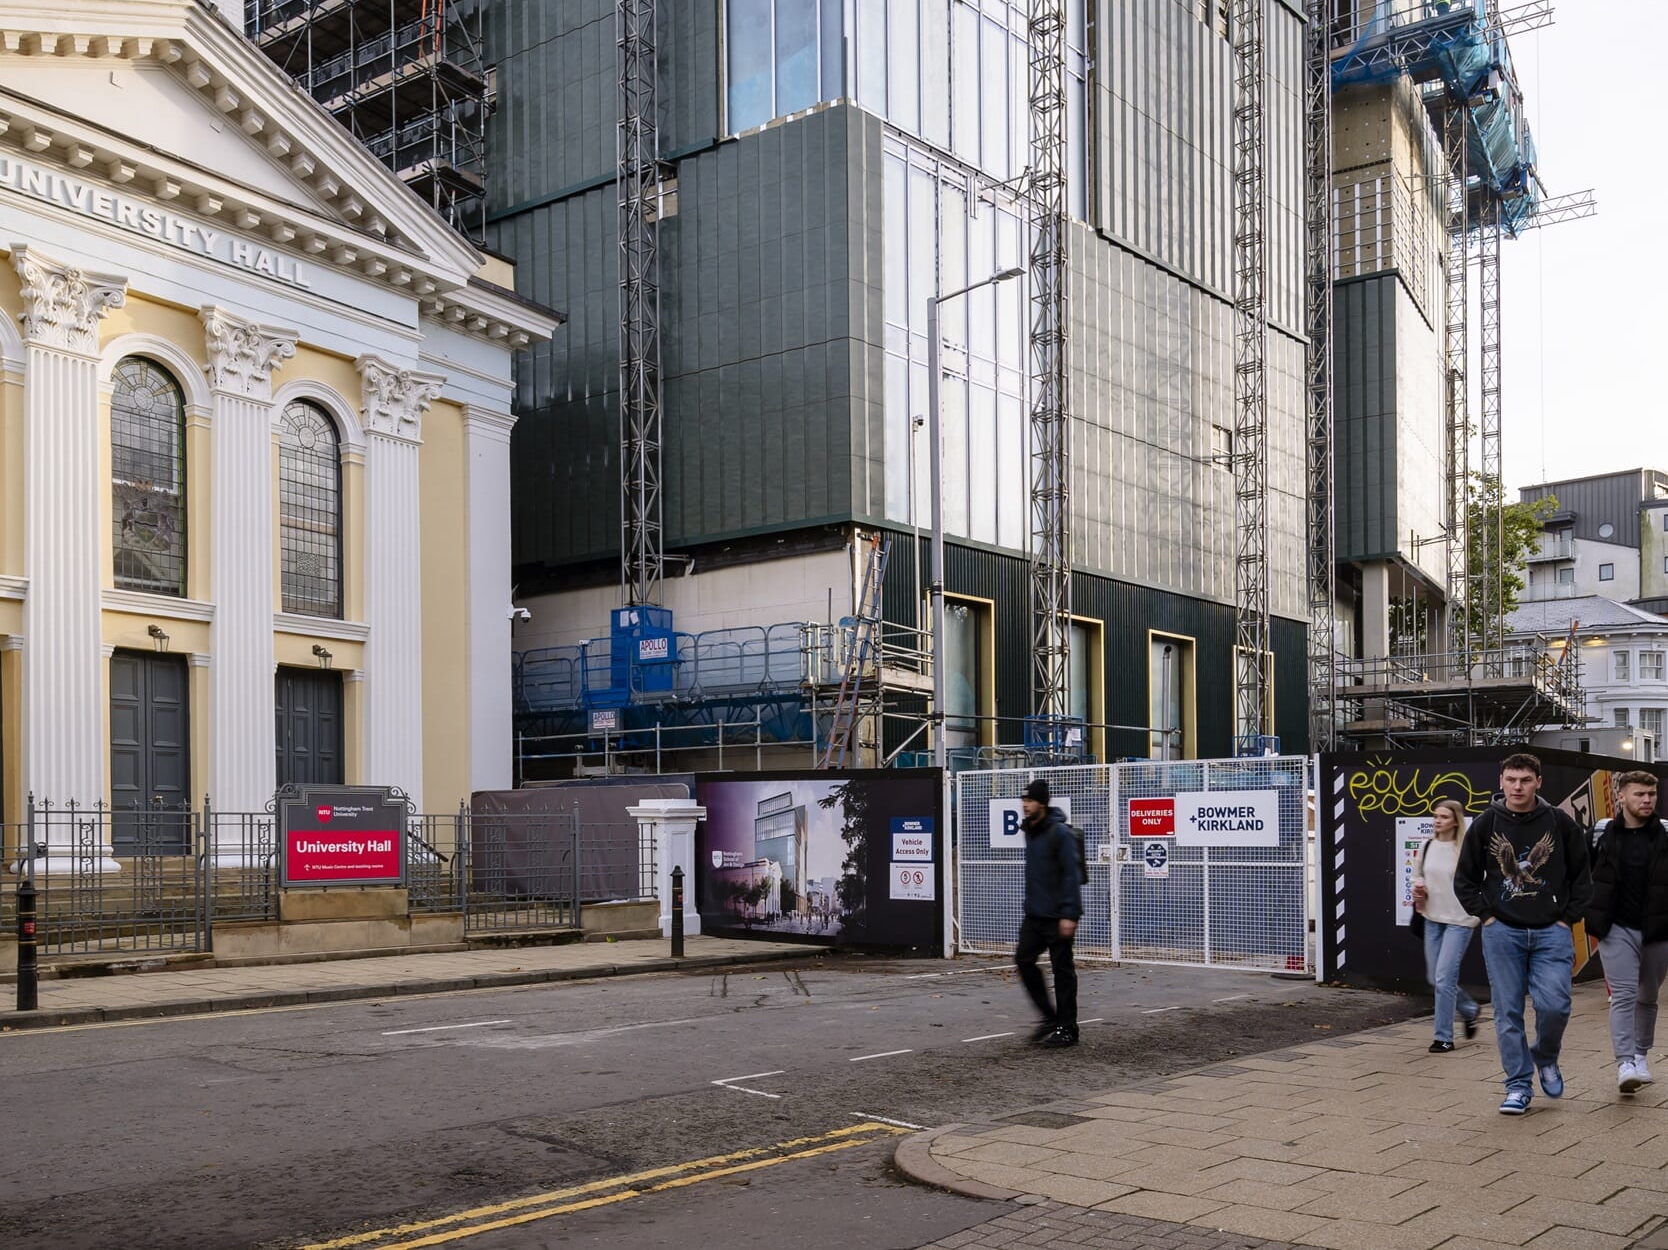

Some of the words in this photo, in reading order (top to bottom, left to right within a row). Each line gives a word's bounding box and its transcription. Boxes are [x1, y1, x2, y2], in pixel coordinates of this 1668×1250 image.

[0, 158, 220, 255] UNIVERSITY
[231, 239, 312, 288] HALL
[641, 638, 667, 651] APOLLO
[1131, 809, 1173, 817] DELIVERIES
[1197, 806, 1256, 819] BOWMER
[1197, 819, 1264, 831] KIRKLAND
[296, 840, 365, 854] University
[367, 840, 392, 852] Hall
[916, 848, 929, 856] Only
